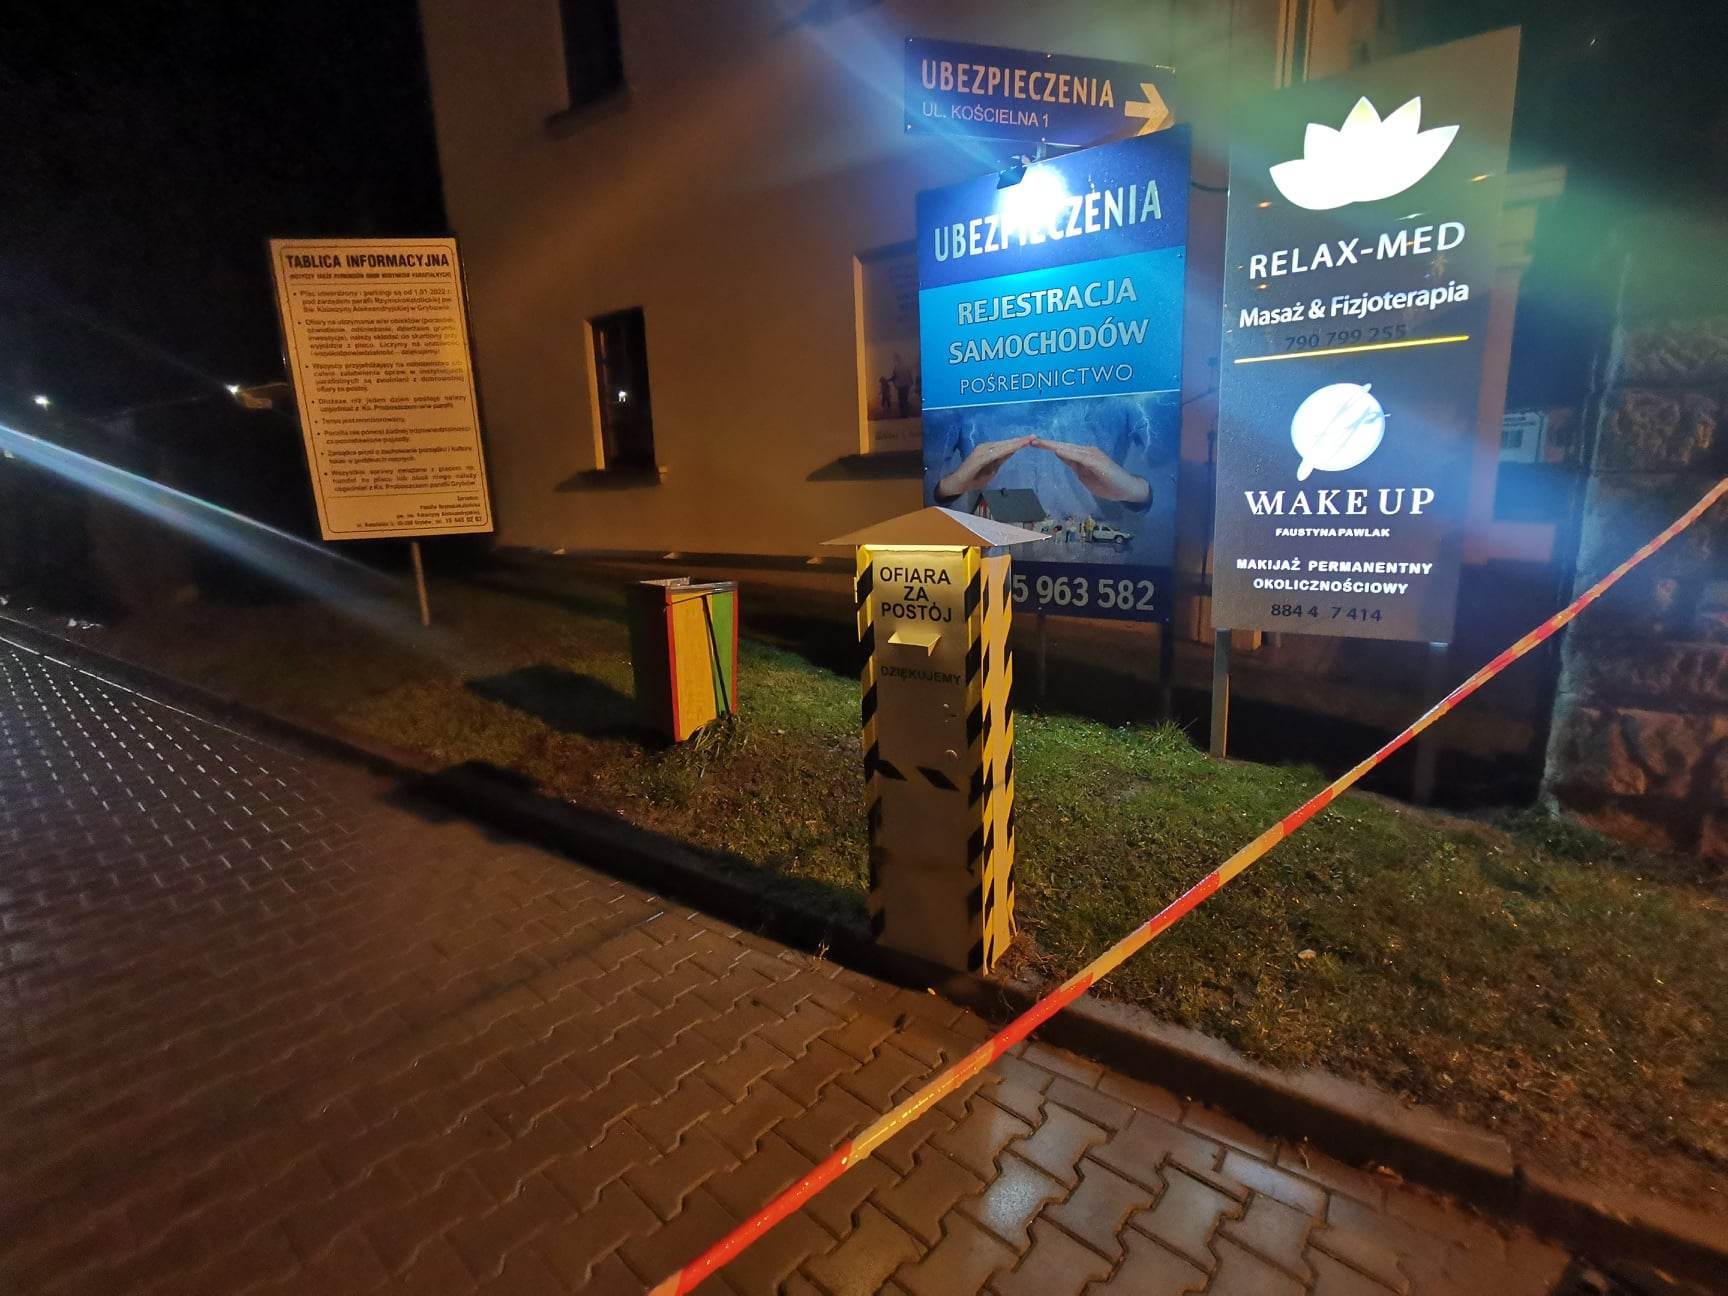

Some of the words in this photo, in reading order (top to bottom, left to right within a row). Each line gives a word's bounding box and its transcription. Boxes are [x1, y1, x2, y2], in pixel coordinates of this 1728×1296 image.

[921, 59, 1115, 108] UBEZPIECZENIA
[923, 102, 946, 118] UL.
[951, 104, 1039, 127] KOŚCIELNA
[1042, 113, 1049, 128] 1
[934, 180, 1162, 262] UBEZPCZENIA
[286, 254, 341, 269] TABLICA
[346, 253, 449, 268] INFORMACYJNA
[1249, 221, 1466, 280] RELAX-MED
[958, 277, 1138, 326] REJESTRACJA
[1239, 302, 1304, 328] Masaż
[1308, 298, 1325, 320] &
[1330, 281, 1469, 319] Fizjoterapia
[949, 317, 1150, 366] SAMOCHODÓW
[1285, 334, 1320, 350] 790
[960, 364, 1134, 395] POŚREDNICTWO
[1378, 487, 1435, 515] UP
[1275, 528, 1337, 537] FAUSTYNA
[1338, 528, 1391, 537] PAWLAK
[880, 567, 951, 585] OFIARA
[1236, 557, 1301, 572] MAKIJAŻ
[1308, 560, 1433, 575] PERMANENTNY
[904, 586, 929, 602] ZA
[1036, 575, 1089, 607] 963
[1098, 579, 1155, 611] 582
[1253, 578, 1409, 595] OKOLICZNOŚCIOWY
[882, 601, 952, 623] POSTÓJ
